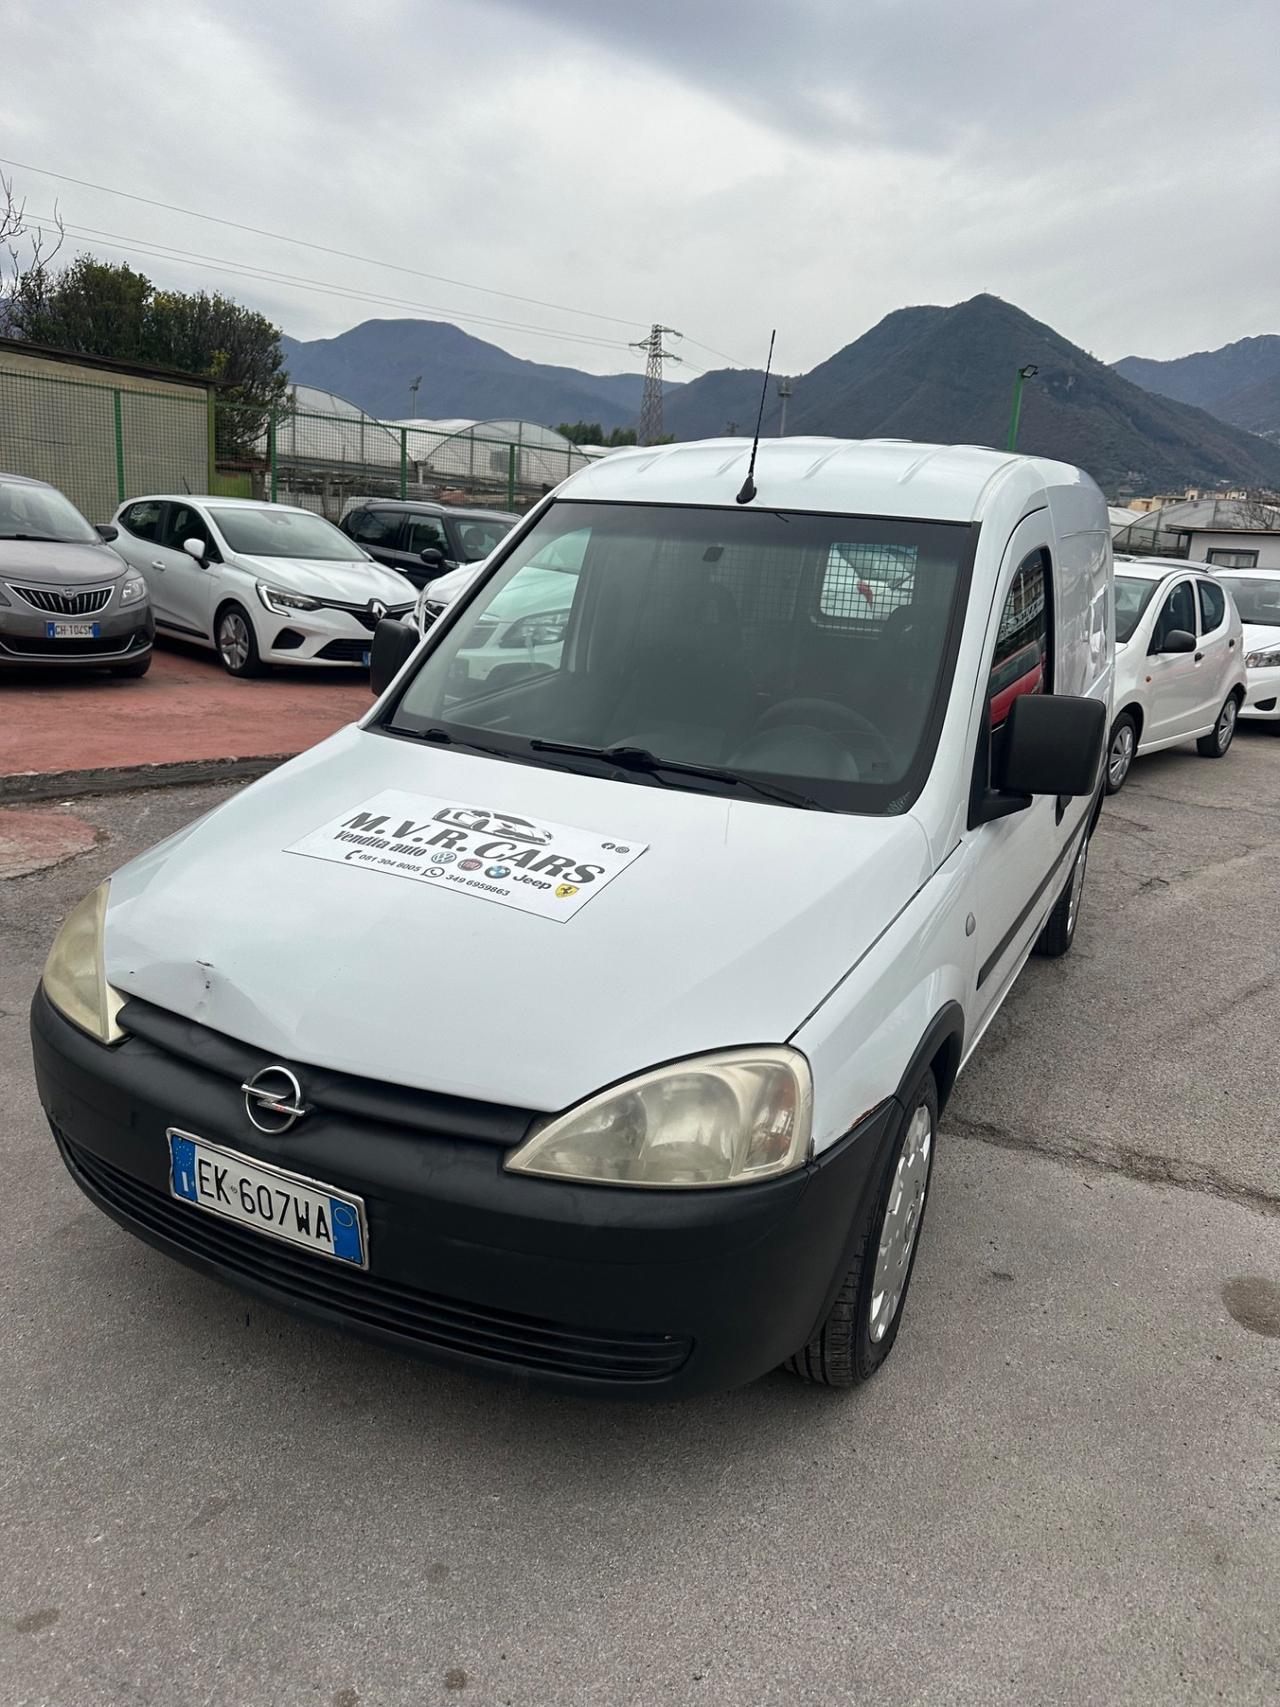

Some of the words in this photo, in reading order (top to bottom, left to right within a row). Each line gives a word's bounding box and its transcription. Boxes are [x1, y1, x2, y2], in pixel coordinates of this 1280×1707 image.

[388, 843, 428, 857] auto
[358, 854, 378, 862] 081
[377, 858, 397, 866] 304
[396, 862, 422, 872] 8005
[445, 874, 466, 884] 349
[465, 880, 511, 897] 6959863
[512, 874, 552, 890] Jeep
